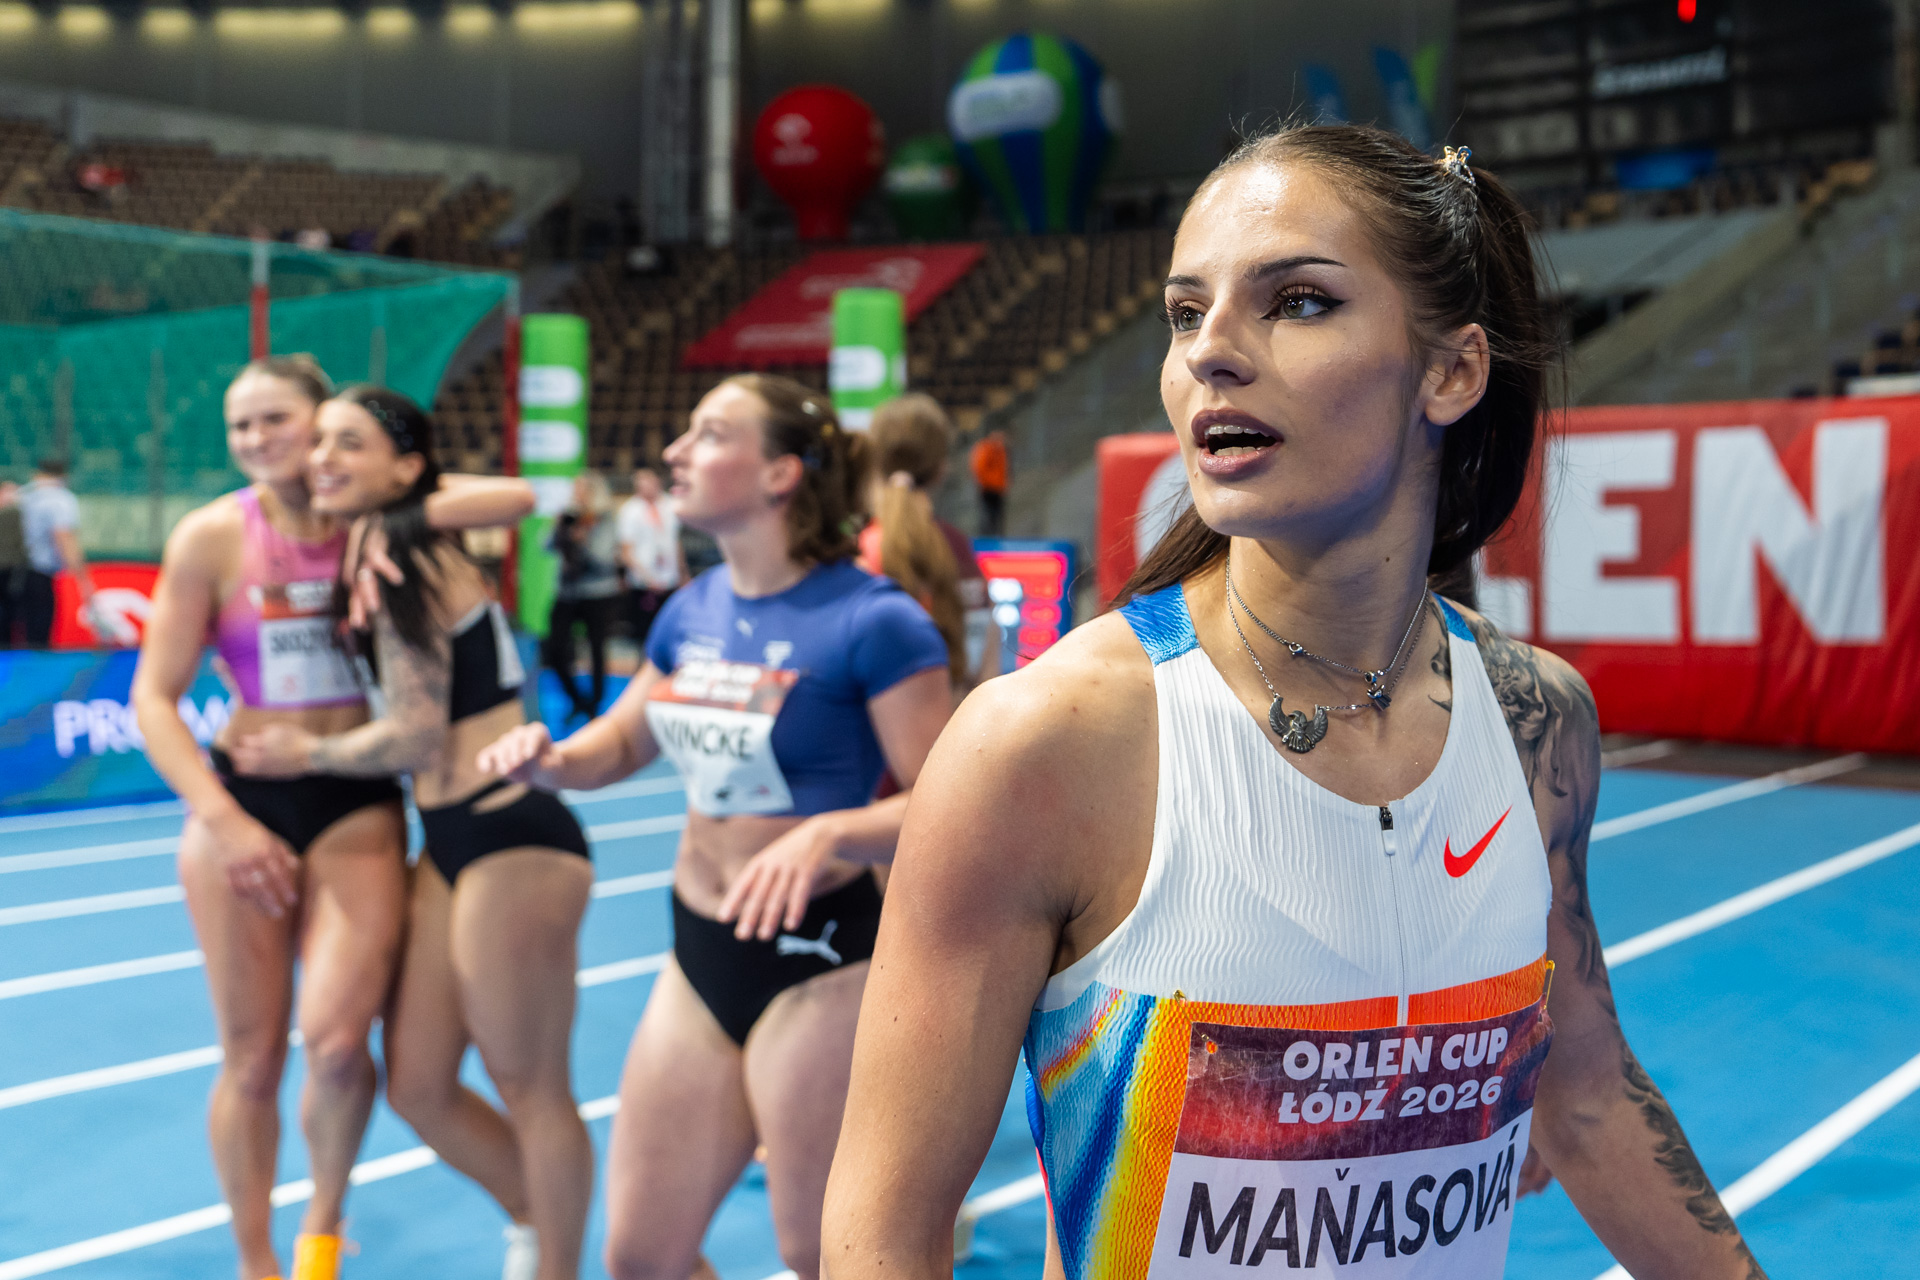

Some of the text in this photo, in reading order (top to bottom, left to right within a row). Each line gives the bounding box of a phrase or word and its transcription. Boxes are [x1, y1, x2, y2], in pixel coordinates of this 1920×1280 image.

[1282, 1026, 1508, 1081] ORLEN CUP
[1278, 1075, 1504, 1124] ŁÓDŹ 2026
[1178, 1123, 1520, 1269] MAŇASOVÁ
